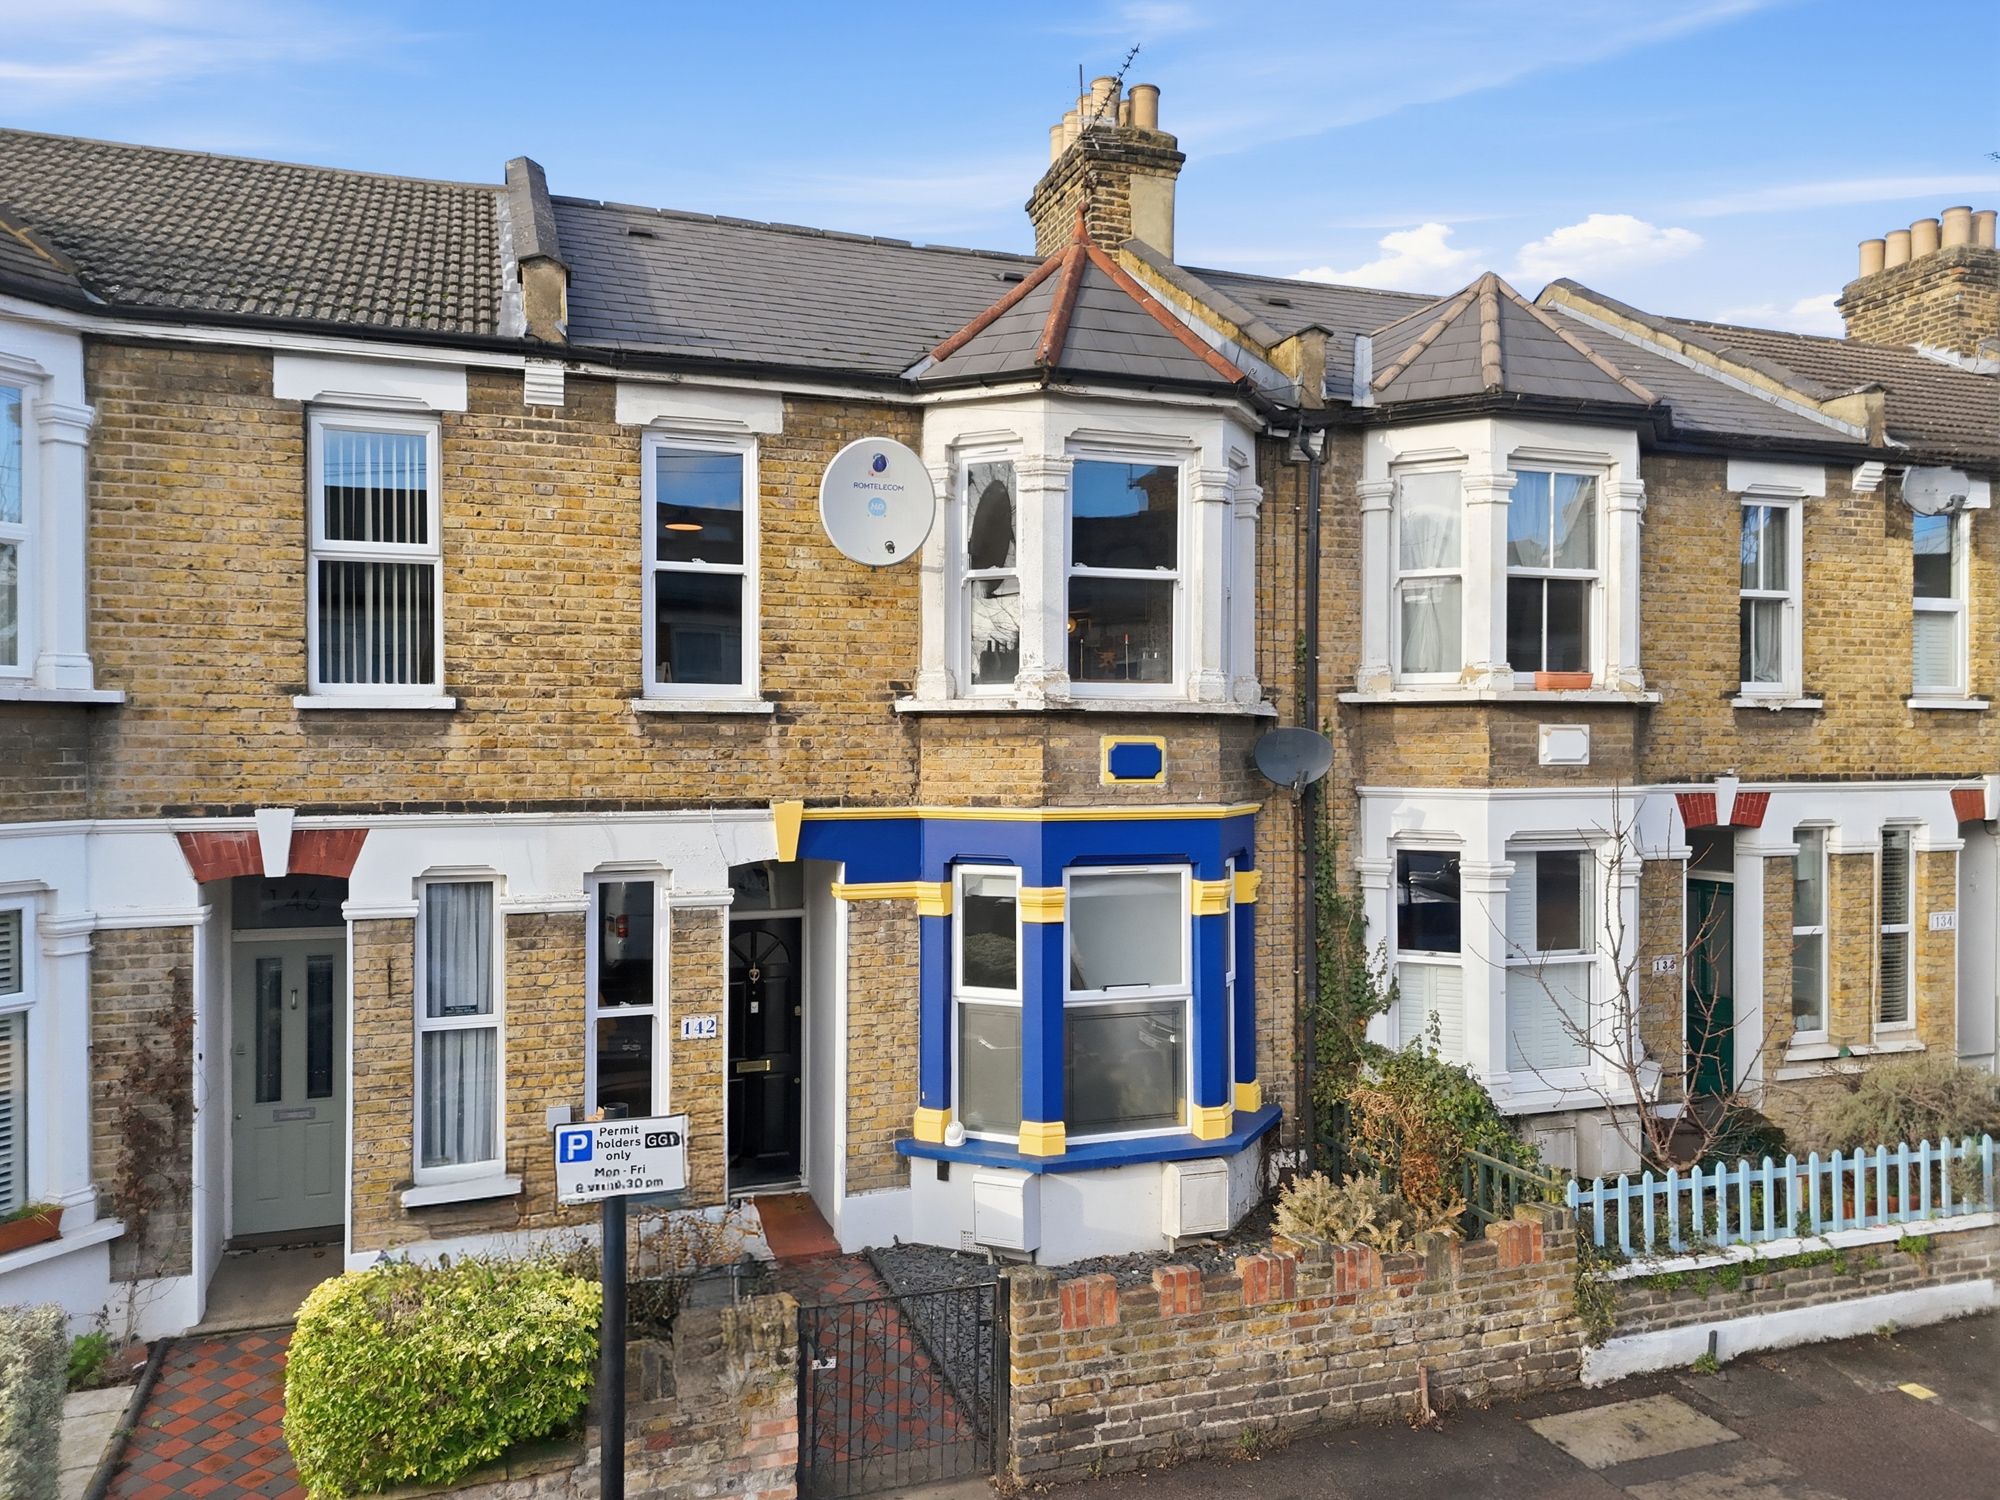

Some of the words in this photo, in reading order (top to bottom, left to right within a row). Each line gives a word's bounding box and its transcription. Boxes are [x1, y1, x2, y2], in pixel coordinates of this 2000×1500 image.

[853, 482, 904, 491] ROMTELECOM
[269, 888, 320, 912] 146
[1936, 915, 1953, 928] 134
[684, 1019, 715, 1035] 142
[599, 1125, 639, 1137] Permit
[567, 1134, 588, 1160] P
[596, 1137, 641, 1149] holders
[606, 1150, 631, 1161] only
[594, 1167, 620, 1177] Mon
[630, 1164, 646, 1175] Fri
